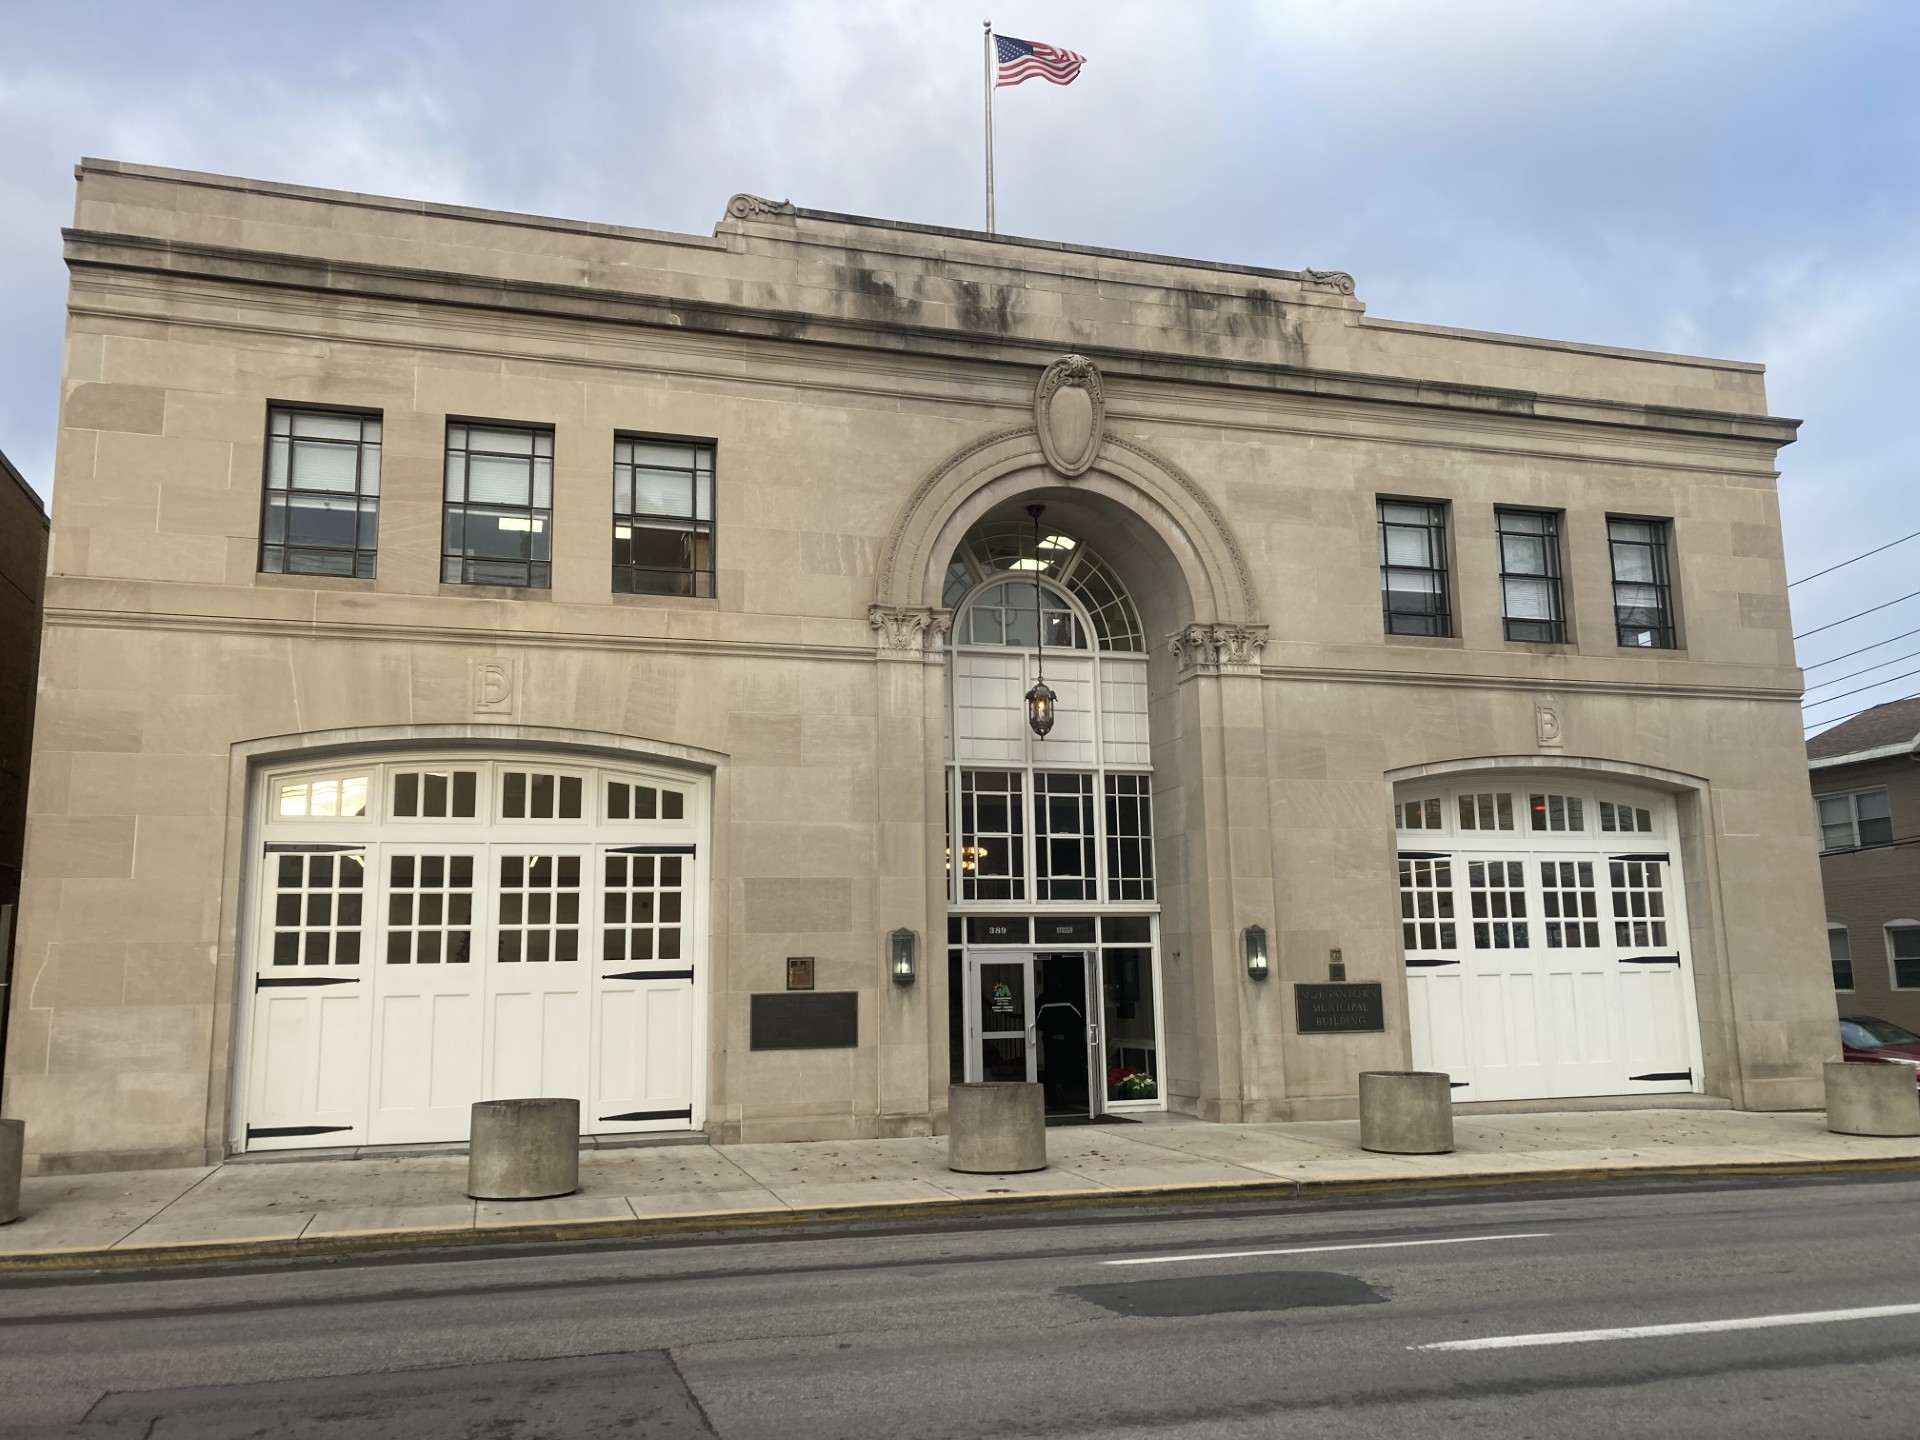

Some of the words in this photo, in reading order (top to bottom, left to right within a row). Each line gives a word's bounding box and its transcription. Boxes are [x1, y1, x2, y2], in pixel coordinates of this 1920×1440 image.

[988, 926, 1007, 934] 389
[1301, 989, 1377, 999] MORGANTOWN
[1312, 1002, 1368, 1012] MUNICIPAL
[1316, 1016, 1366, 1026] BUILDING
